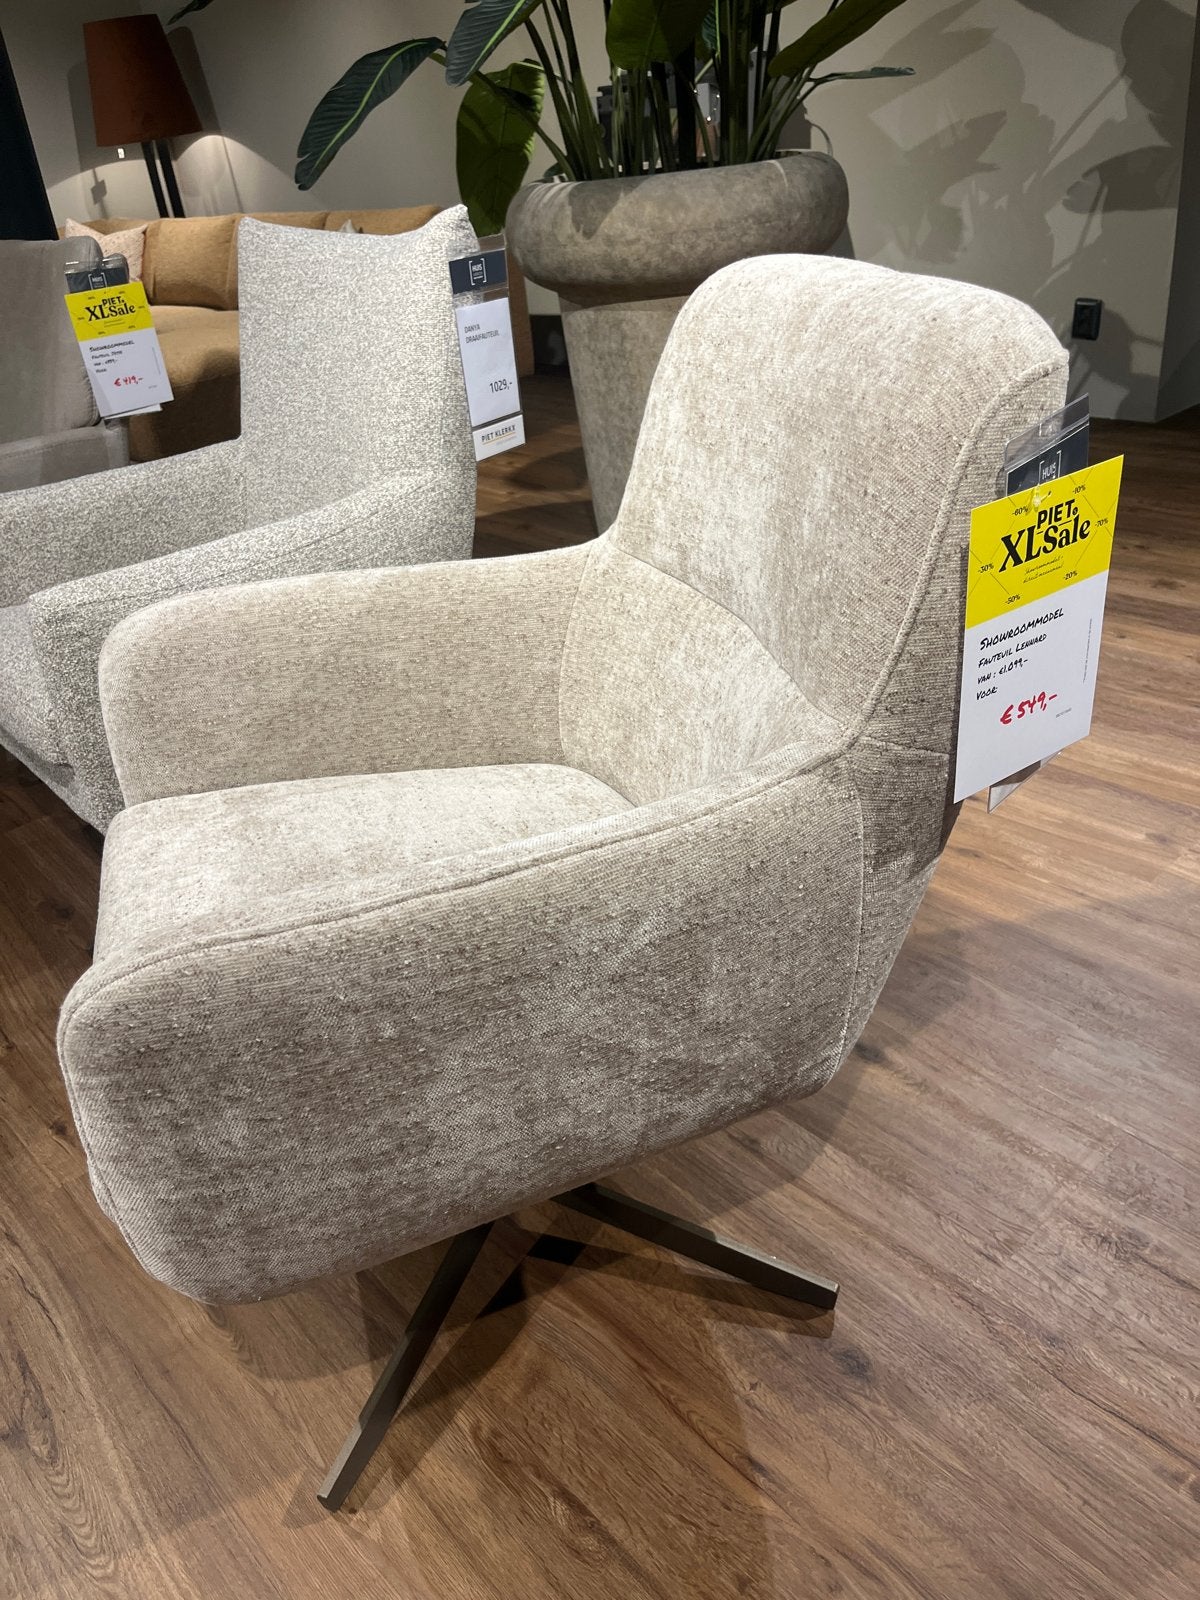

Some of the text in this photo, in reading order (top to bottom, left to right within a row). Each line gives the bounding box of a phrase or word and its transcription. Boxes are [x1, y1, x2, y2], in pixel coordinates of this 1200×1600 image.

[102, 296, 121, 306] PIET
[465, 324, 481, 333] DANYA
[490, 379, 512, 393] 1029,-
[482, 431, 494, 442] PIET
[495, 425, 516, 438] KLERKX
[980, 608, 1064, 650] SHOWROOMMODEL
[978, 648, 1013, 668] FAUTEUIL
